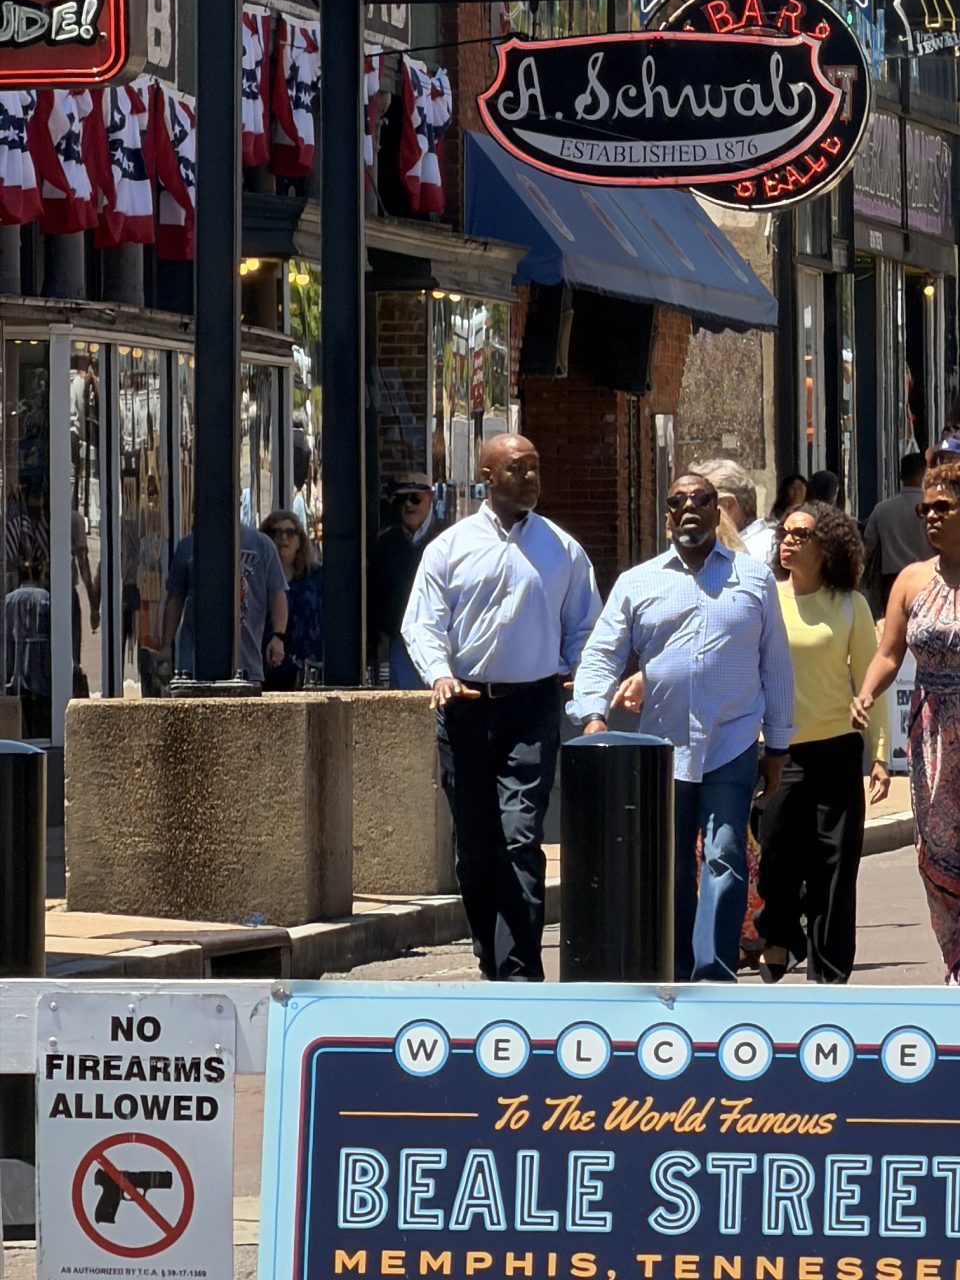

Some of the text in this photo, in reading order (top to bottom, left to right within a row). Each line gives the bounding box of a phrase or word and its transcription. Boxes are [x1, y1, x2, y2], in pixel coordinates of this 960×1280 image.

[498, 56, 563, 120] A.
[574, 52, 815, 120] Schwab
[559, 138, 758, 163] ESTABLISHED 1876
[111, 1015, 161, 1043] NO
[45, 1053, 226, 1084] FIREARMS
[49, 1092, 219, 1122] ALLOWED
[494, 1094, 838, 1135] To The World Famous
[337, 1146, 616, 1234] BEALE
[73, 1266, 124, 1276] AUTHORIZED
[125, 1267, 137, 1276] BY
[334, 1249, 616, 1280] MEMPHIS,
